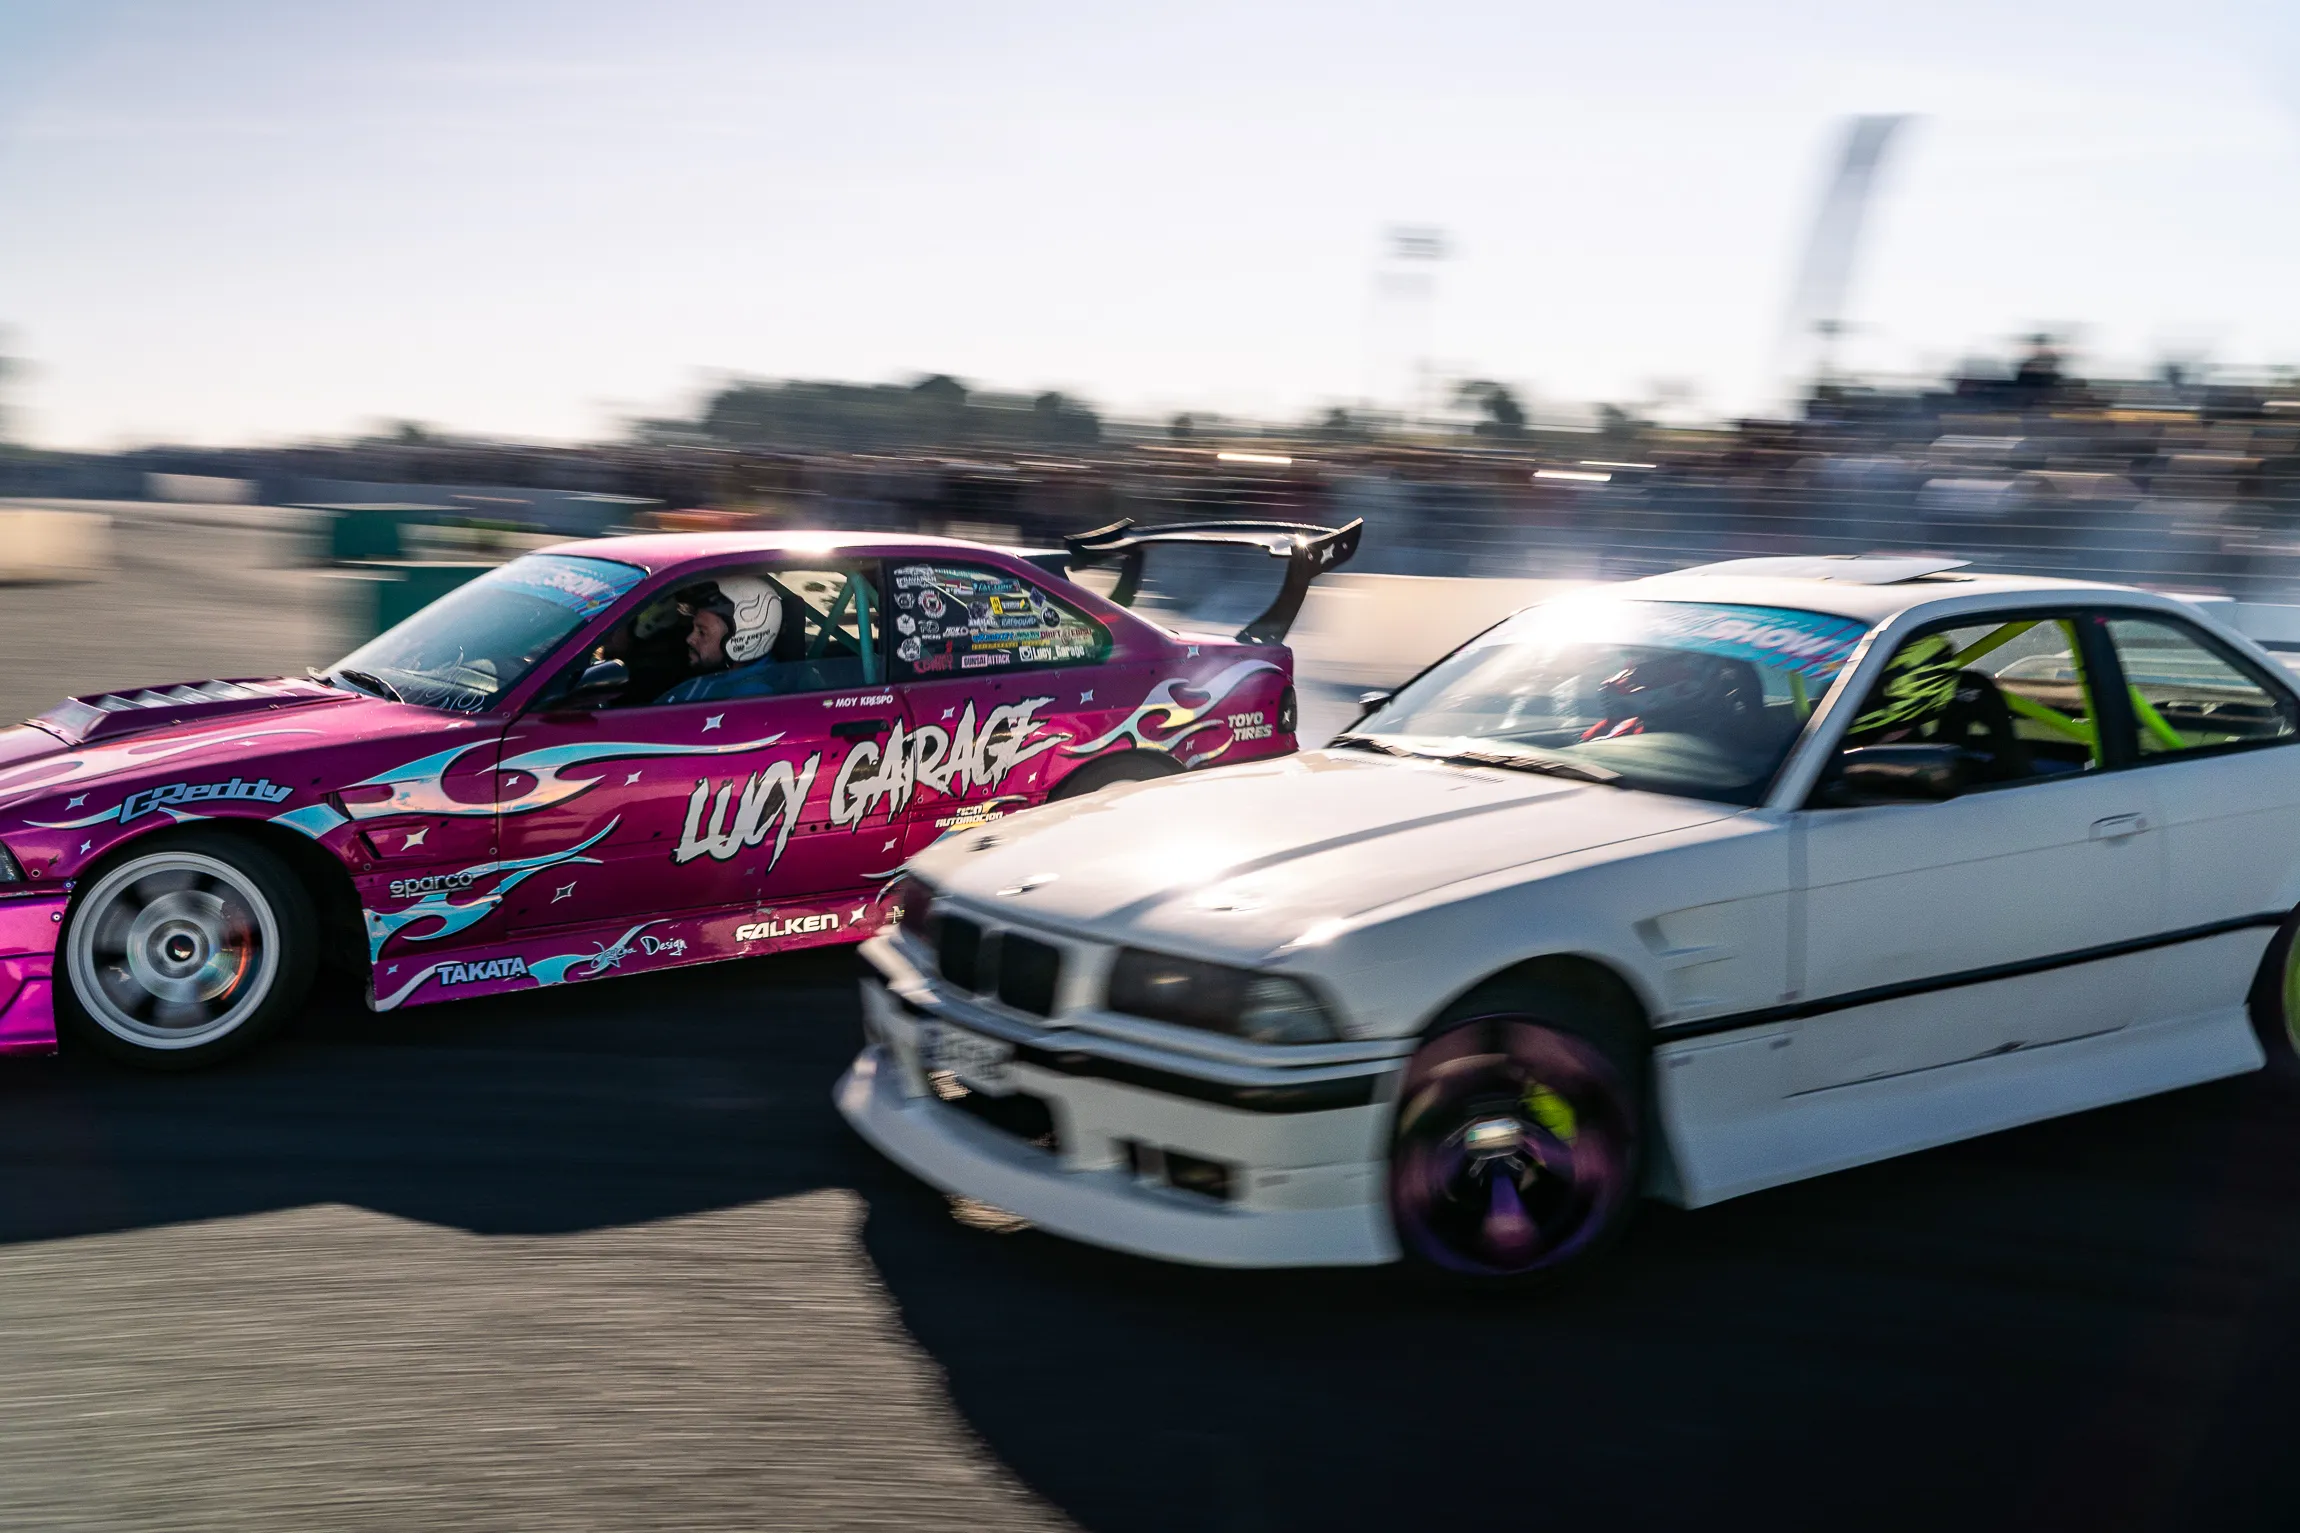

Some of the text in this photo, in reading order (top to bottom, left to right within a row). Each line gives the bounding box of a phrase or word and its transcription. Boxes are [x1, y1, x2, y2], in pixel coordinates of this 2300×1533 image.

[987, 654, 1010, 665] ATTACK
[1033, 645, 1085, 660] Lucy_Garage
[835, 694, 894, 708] MOY KRESPO
[1227, 711, 1264, 728] TOYO
[1233, 724, 1273, 742] TIRES
[674, 697, 1074, 873] LUCY GARAGE
[119, 778, 294, 824] GReddy
[935, 811, 1004, 828] AUTOMOCION
[389, 872, 474, 898] sparco
[735, 913, 839, 942] FALKEN
[640, 936, 688, 956] Design
[437, 957, 527, 985] TAKATA
